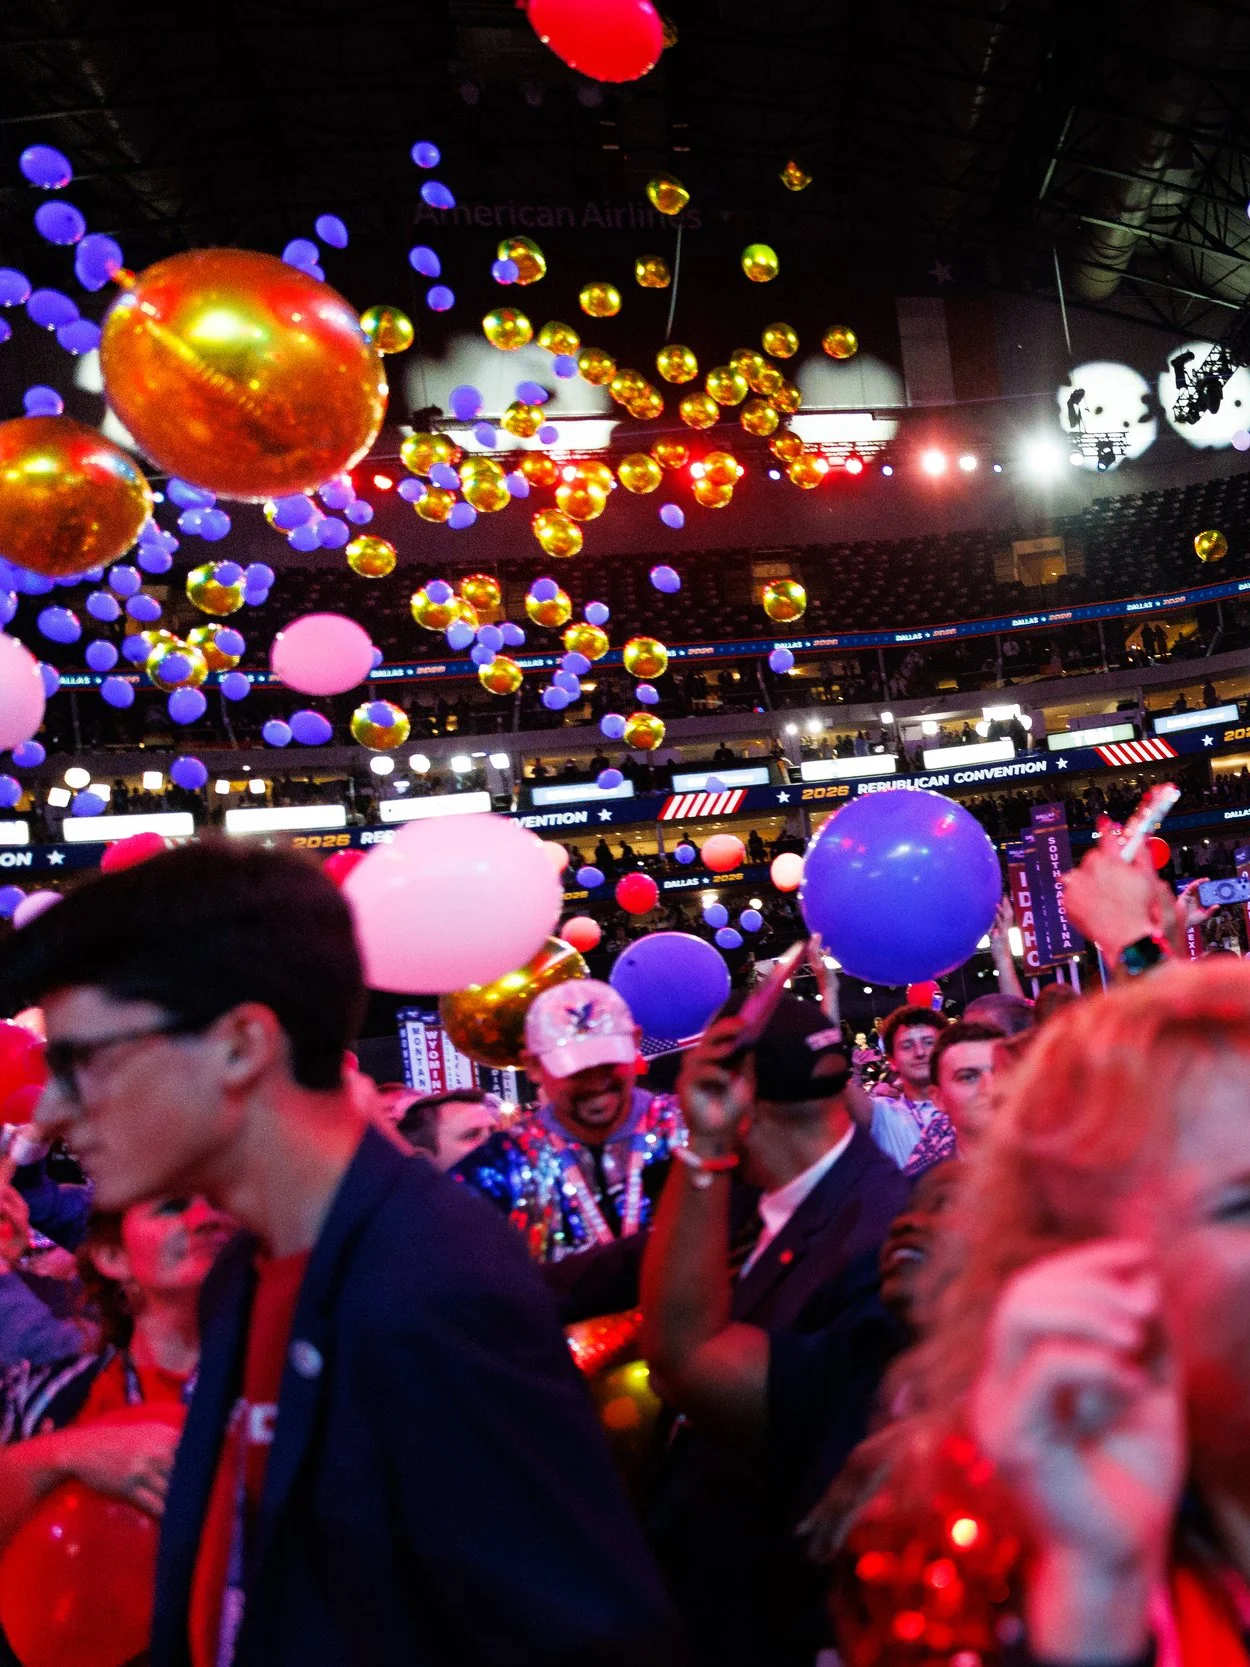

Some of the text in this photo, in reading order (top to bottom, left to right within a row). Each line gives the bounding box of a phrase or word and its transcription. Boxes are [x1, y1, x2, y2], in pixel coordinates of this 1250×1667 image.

[1126, 601, 1153, 611] DALLAS
[1011, 617, 1039, 627] DALLAS
[774, 641, 803, 649] DALLAS
[895, 632, 923, 642] DALLAS
[58, 676, 92, 685] ALLAS
[801, 760, 1048, 800] 2026 REPUBLICAN CONVENTION
[513, 810, 588, 829] VENTION
[292, 833, 352, 850] 2026
[663, 872, 744, 889] DALLAS 2026
[561, 890, 589, 900] 026
[1047, 836, 1072, 948] SOUTH CAROLINA
[1018, 871, 1040, 967] IDAHO
[411, 1027, 426, 1087] MONTAN
